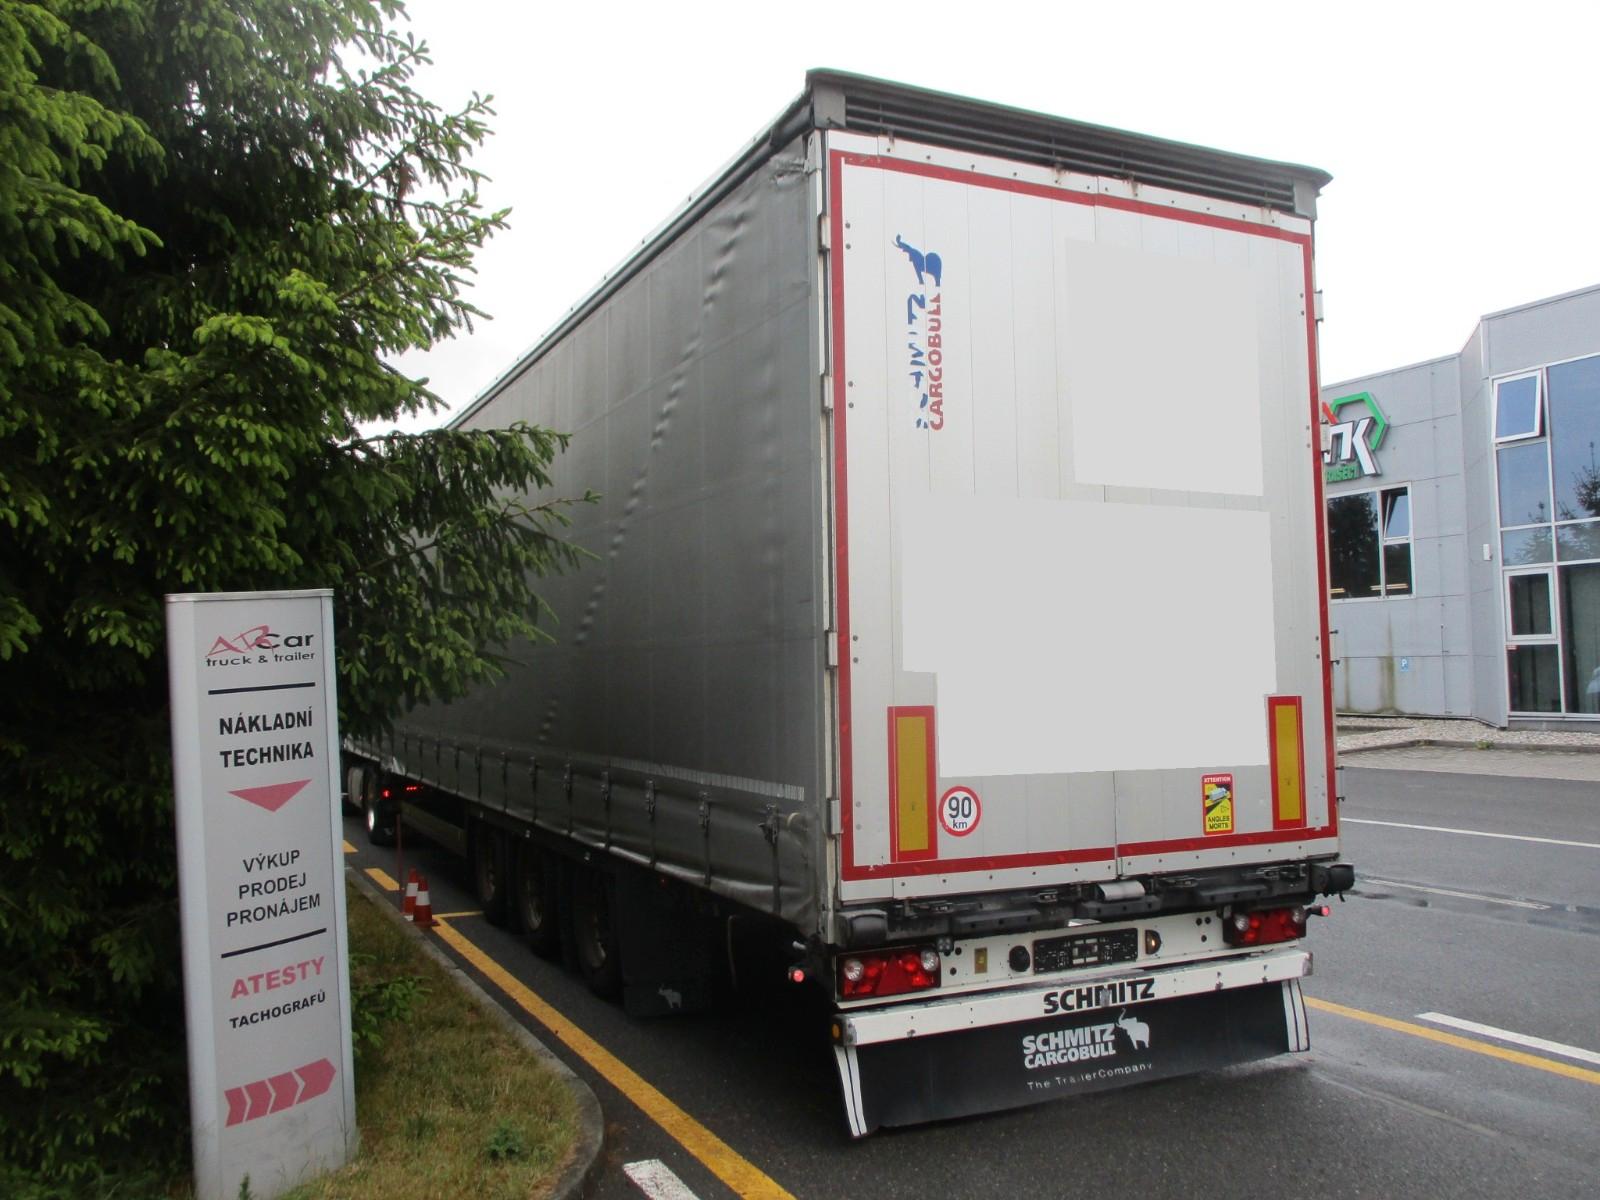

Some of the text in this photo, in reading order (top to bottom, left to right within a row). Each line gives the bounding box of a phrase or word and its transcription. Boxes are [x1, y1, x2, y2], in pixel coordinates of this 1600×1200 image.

[927, 292, 944, 431] CARGOBULL
[206, 652, 315, 667] truck & trailer
[219, 706, 313, 736] NÁKLADNÍ
[219, 741, 314, 769] TECHNIKA
[948, 796, 972, 819] 90
[1208, 815, 1230, 823] ANGLES
[952, 819, 968, 829] km
[1209, 822, 1229, 830] MORTS
[243, 849, 300, 873] VÝKUP
[238, 872, 306, 899] PRODEJ
[227, 893, 321, 927] PRONÁJEM
[230, 956, 325, 999] ATESTY
[1043, 978, 1155, 1014] SCHMITZ
[1022, 1022, 1116, 1054] SCHMITZ
[1024, 1041, 1117, 1069] CARGOBULL
[1027, 1077, 1051, 1090] The
